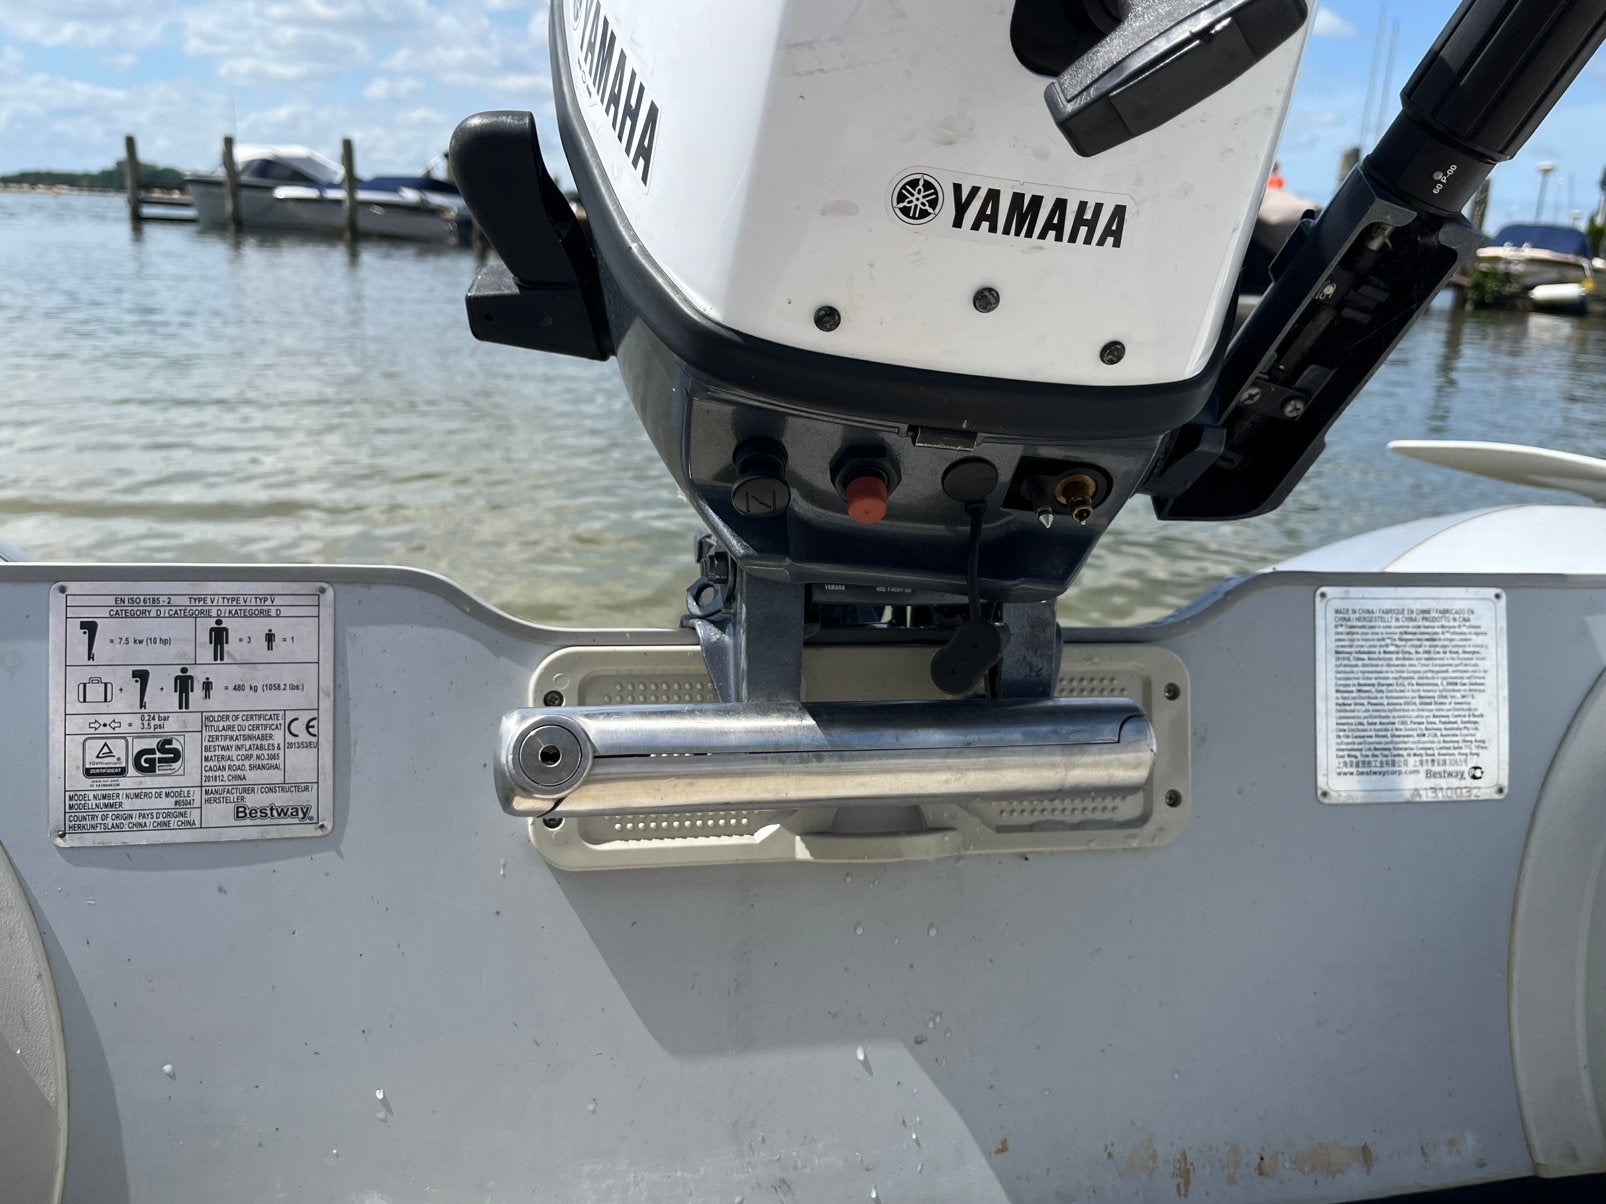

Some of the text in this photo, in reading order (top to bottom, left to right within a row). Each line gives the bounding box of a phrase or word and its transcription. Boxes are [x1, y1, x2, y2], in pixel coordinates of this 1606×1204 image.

[580, 0, 659, 187] YAMAHA
[1432, 164, 1457, 194] 60 P-00
[952, 182, 1127, 248] YAMAHA
[109, 609, 152, 617] CATEGORY
[168, 608, 212, 616] CATÉGORIE
[228, 608, 272, 616] KATEGORIE
[118, 637, 130, 645] 7.5
[134, 637, 144, 645] kw
[146, 637, 158, 646] (10
[159, 637, 172, 646] hp)
[250, 684, 258, 693] kg
[262, 683, 288, 693] (1058.2
[204, 714, 230, 722] HOLDER
[232, 714, 240, 722] OF
[242, 713, 280, 721] CERTIFICATE
[154, 722, 165, 731] psi
[204, 724, 236, 732] TITULAIRE
[248, 723, 282, 731] CERTIFICAT
[288, 717, 317, 737] CE
[204, 744, 234, 752] BESTWAY
[234, 744, 274, 752] INFLATABLES
[204, 763, 282, 772] CAOAN ROAD, SHANGHAI,
[204, 774, 226, 782] 201812,
[1336, 769, 1466, 780] www.bestwaycorp.com Bestway
[204, 787, 256, 796] MANUFACTURER
[260, 785, 310, 794] CONSTRUCTEUR
[68, 794, 91, 802] MODEL
[92, 792, 120, 800] NUMBER
[126, 790, 152, 800] NUMÉRO
[204, 796, 246, 804] HERSTELLER:
[174, 799, 195, 807] #65047
[68, 814, 99, 822] COUNTRY
[100, 814, 110, 822] OF
[111, 812, 134, 820] ORIGIN
[138, 812, 154, 820] PAYS
[156, 811, 188, 819] D'ORIGINE
[235, 804, 311, 820] Bestway
[68, 822, 126, 832] HERKUNFTSLAND:
[128, 822, 148, 830] CHINA
[152, 821, 172, 829] CHINE
[176, 820, 196, 828] CHINA
